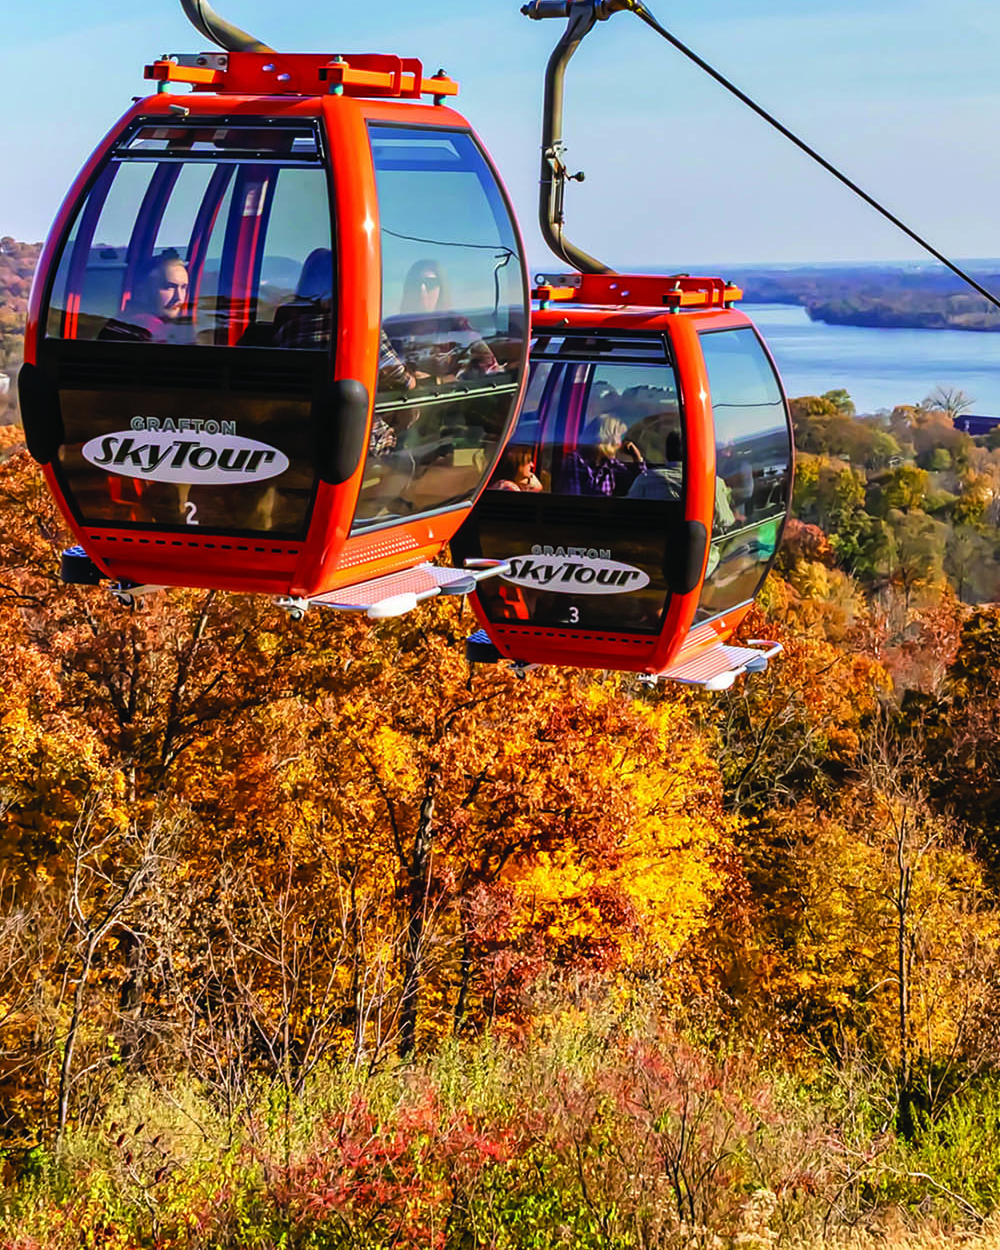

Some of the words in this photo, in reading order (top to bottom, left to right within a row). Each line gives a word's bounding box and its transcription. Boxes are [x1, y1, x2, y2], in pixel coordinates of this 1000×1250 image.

[130, 415, 237, 435] GRAFTON
[94, 437, 276, 472] SkyTour
[184, 502, 199, 525] 2
[531, 544, 611, 559] GRAFTON
[503, 559, 640, 586] SkyTour
[568, 607, 579, 623] 3
